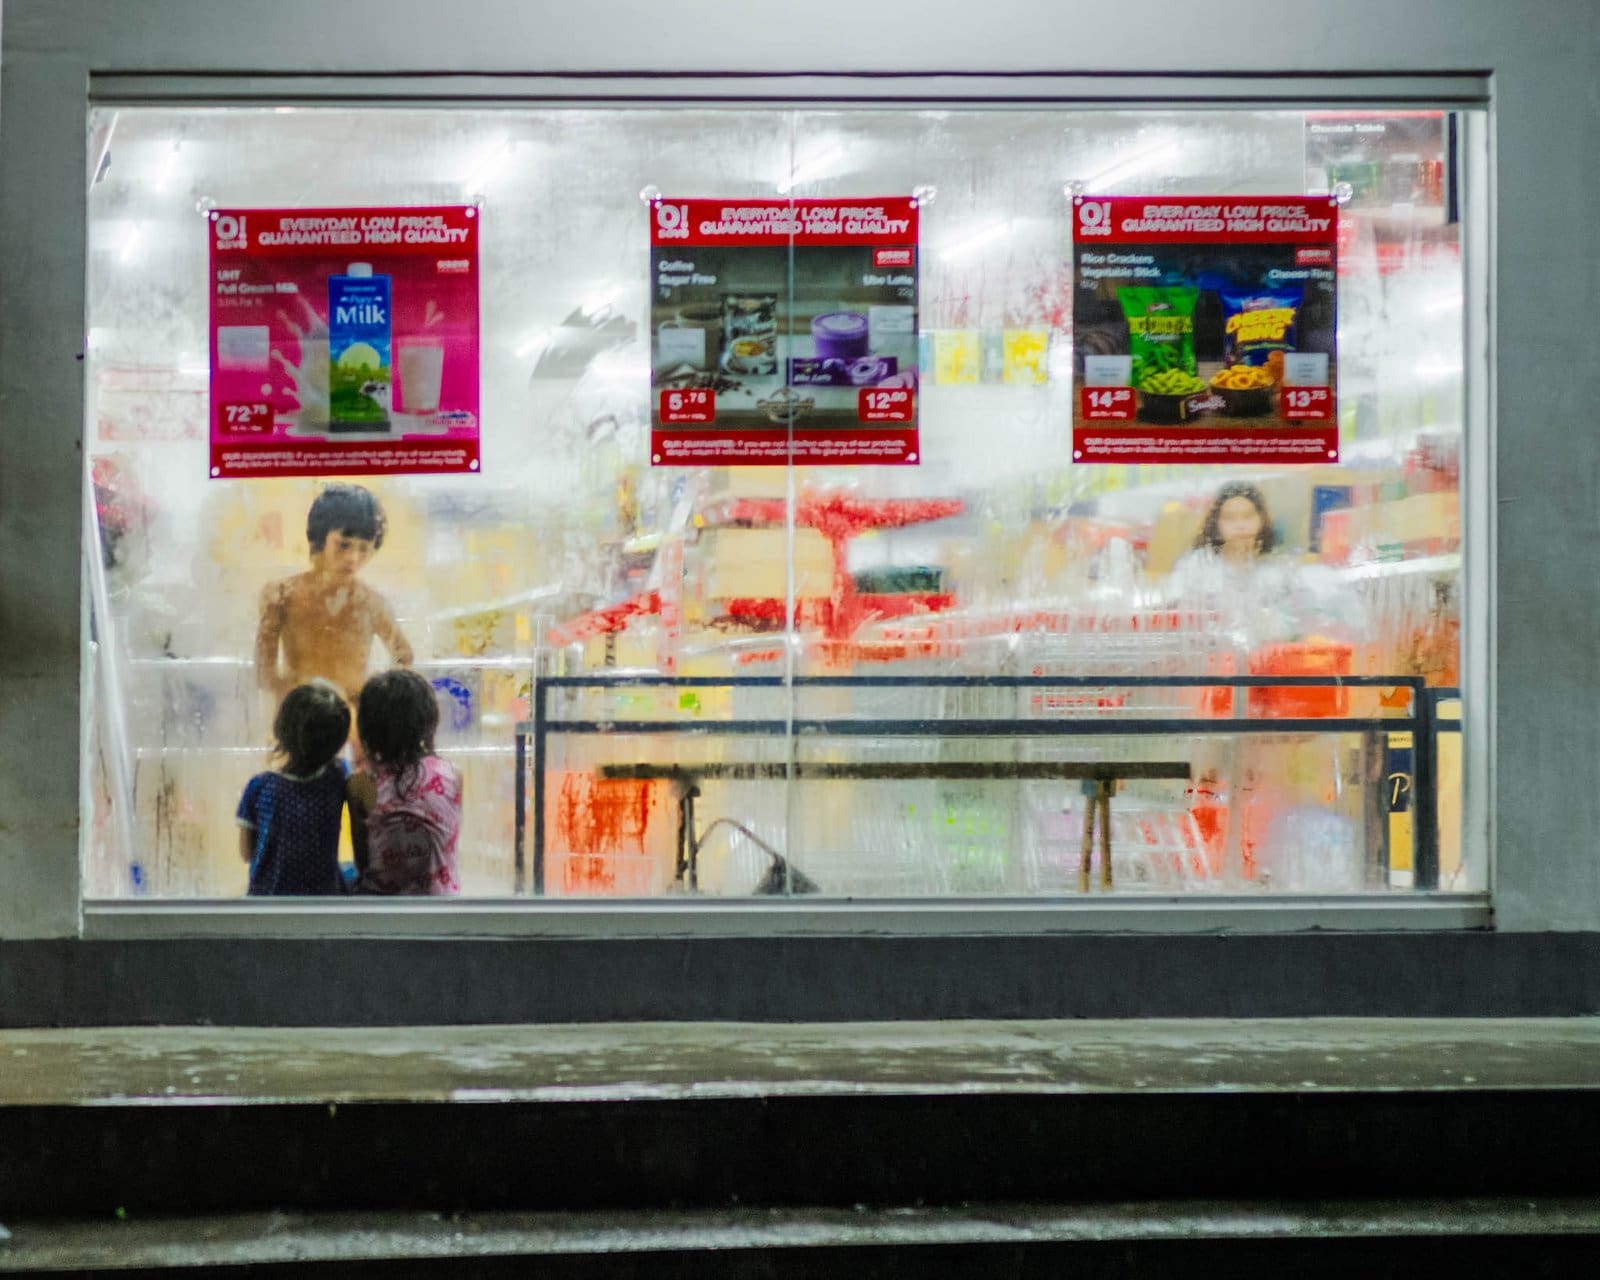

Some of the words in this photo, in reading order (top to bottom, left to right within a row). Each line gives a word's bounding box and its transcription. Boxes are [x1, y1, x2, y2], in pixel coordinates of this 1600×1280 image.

[657, 205, 688, 227] O!
[721, 208, 798, 220] EVERYDAY
[802, 208, 837, 220] LOW
[1079, 202, 1111, 225] O!
[1143, 205, 1220, 218] EVERYDAY
[1224, 205, 1258, 218] LOW
[215, 215, 246, 240] O!
[280, 217, 357, 231] EVERYDAY
[361, 216, 396, 229] LOW
[699, 221, 802, 234] GUARANTEED
[805, 221, 842, 233] HIGH
[845, 220, 909, 233] QUALITY
[1121, 219, 1224, 231] GUARANTEED
[1227, 219, 1264, 231] HIGH
[1267, 219, 1330, 231] QUALITY
[258, 230, 361, 245] GUARANTEED
[365, 229, 402, 243] HIGH
[404, 228, 468, 242] QUALITY
[658, 260, 694, 271] Coffee
[336, 305, 384, 324] Milk
